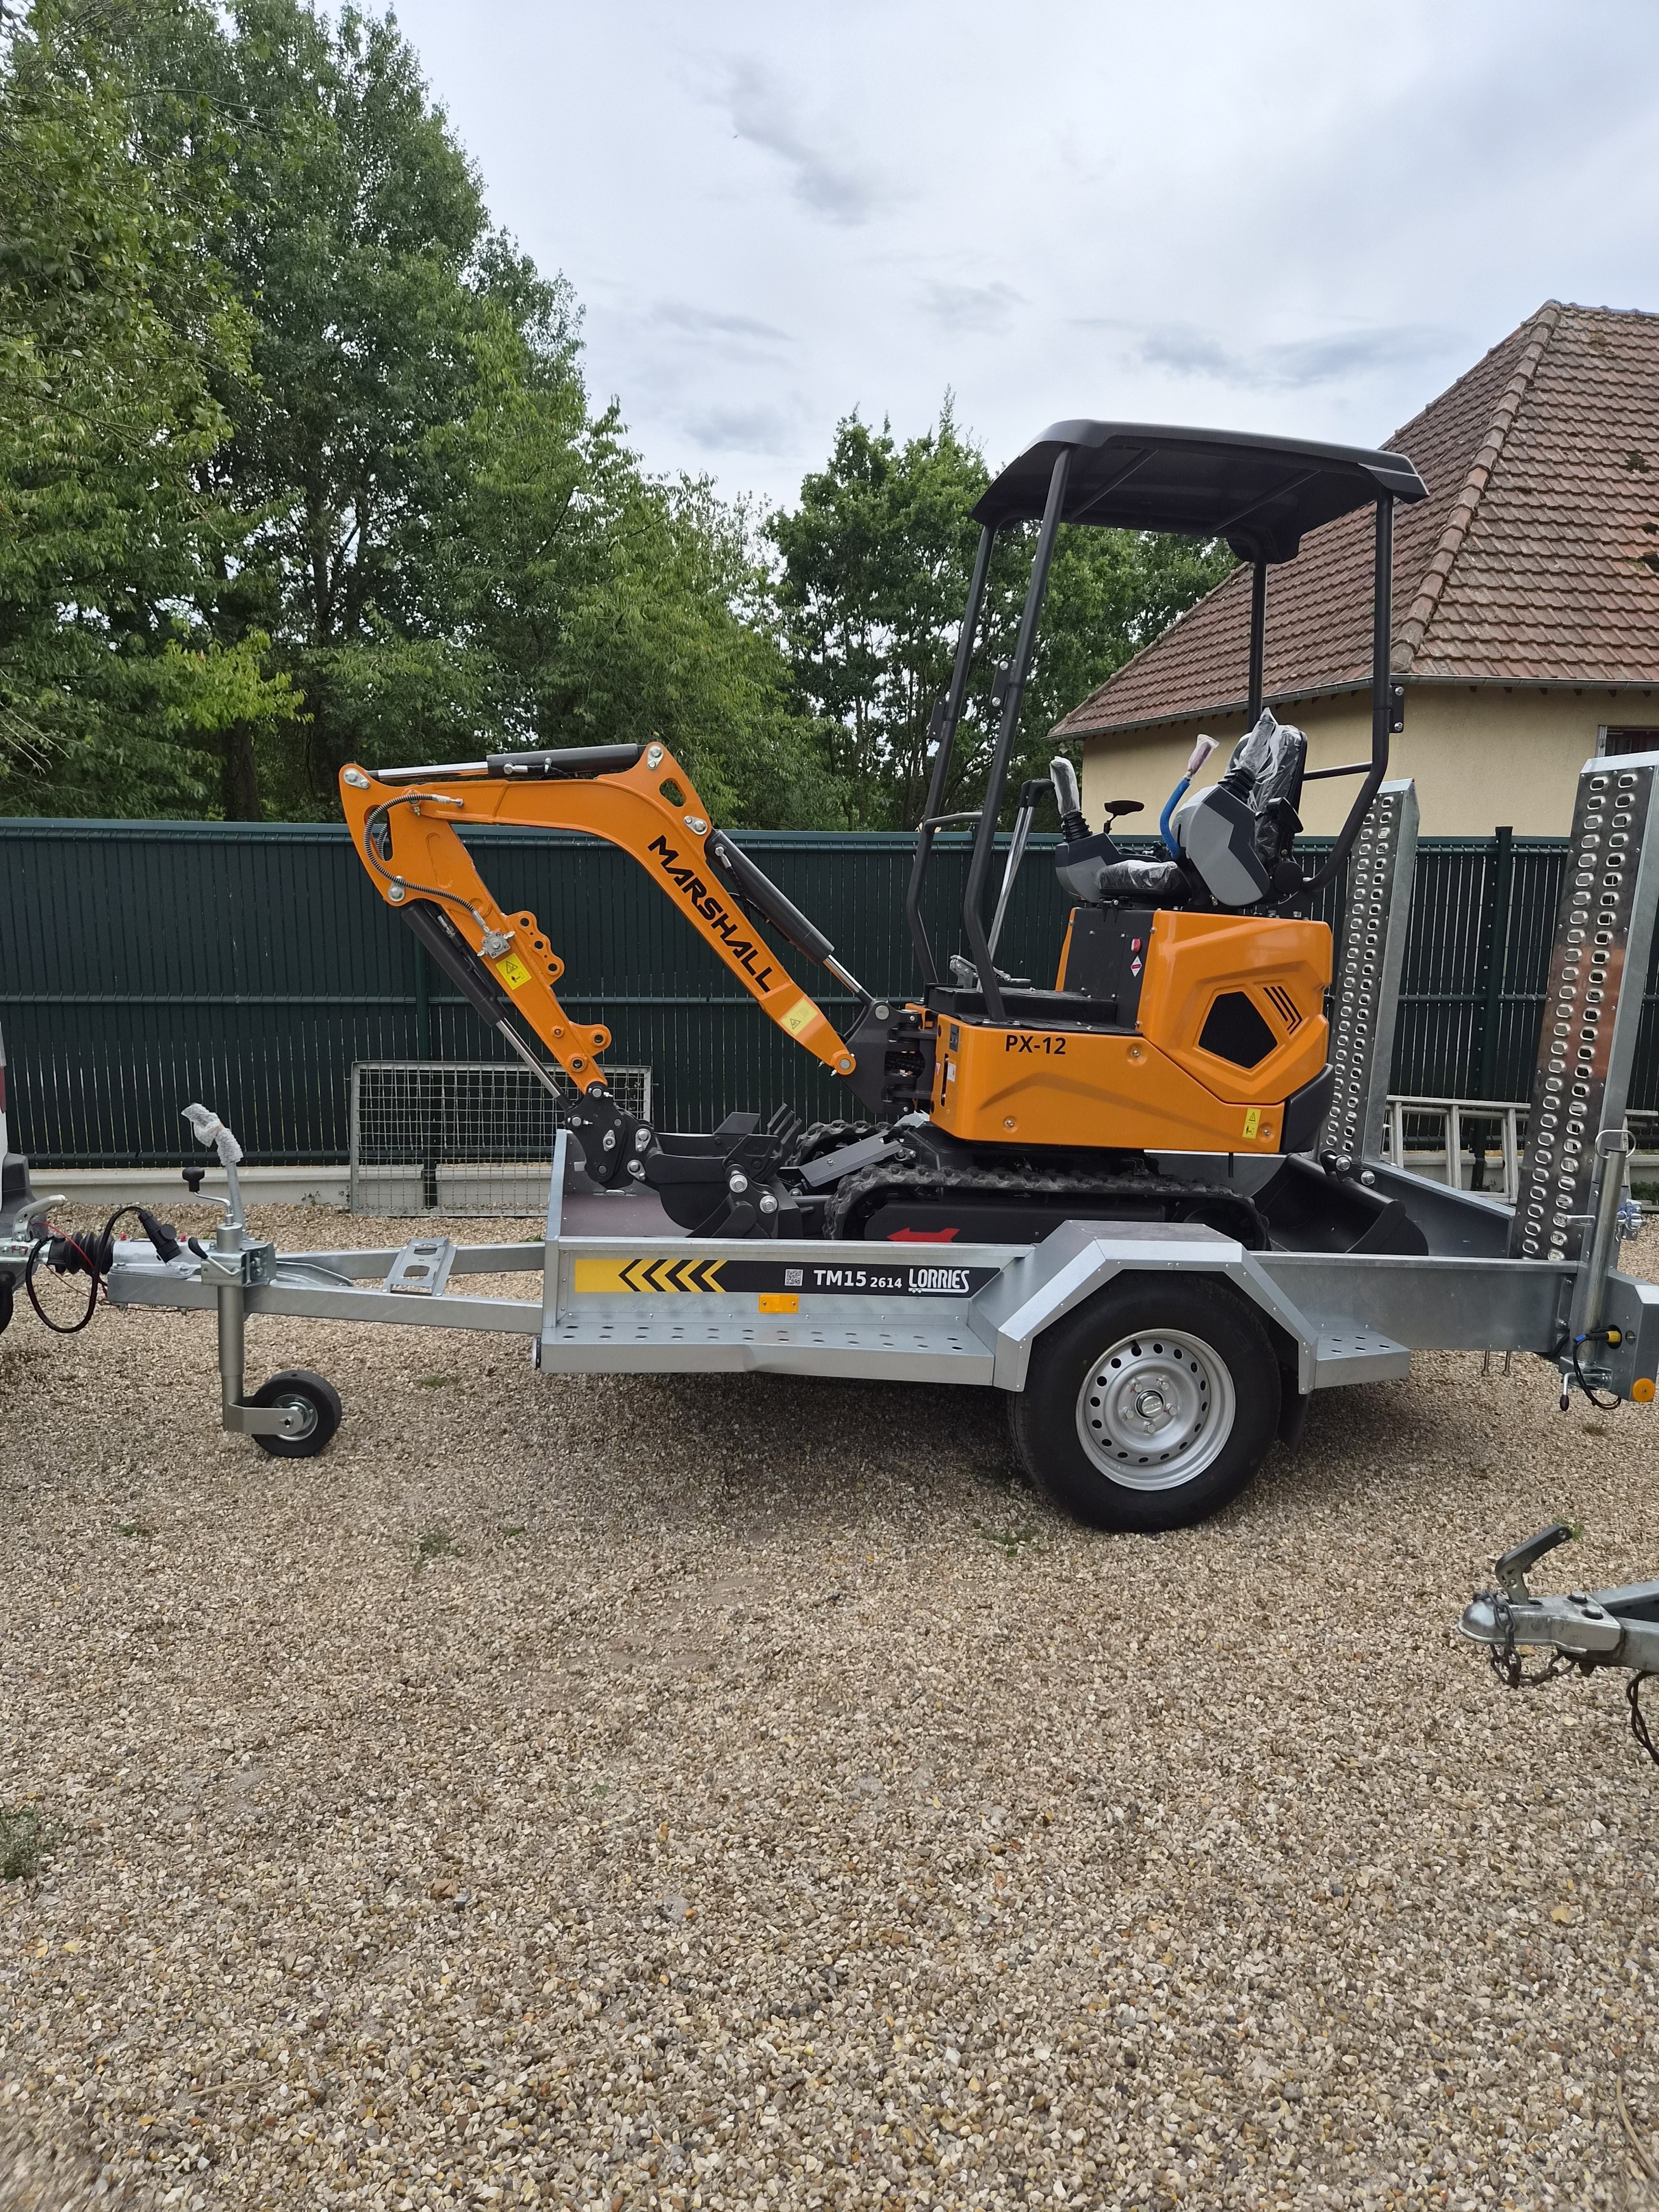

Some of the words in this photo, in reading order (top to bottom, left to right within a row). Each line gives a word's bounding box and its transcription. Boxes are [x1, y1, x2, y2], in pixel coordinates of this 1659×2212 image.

[647, 834, 773, 993] MARSHALL
[1005, 1034, 1067, 1055] PX-12
[813, 1269, 867, 1287] TM15
[870, 1277, 902, 1288] 2614
[909, 1268, 970, 1293] LORRIES
